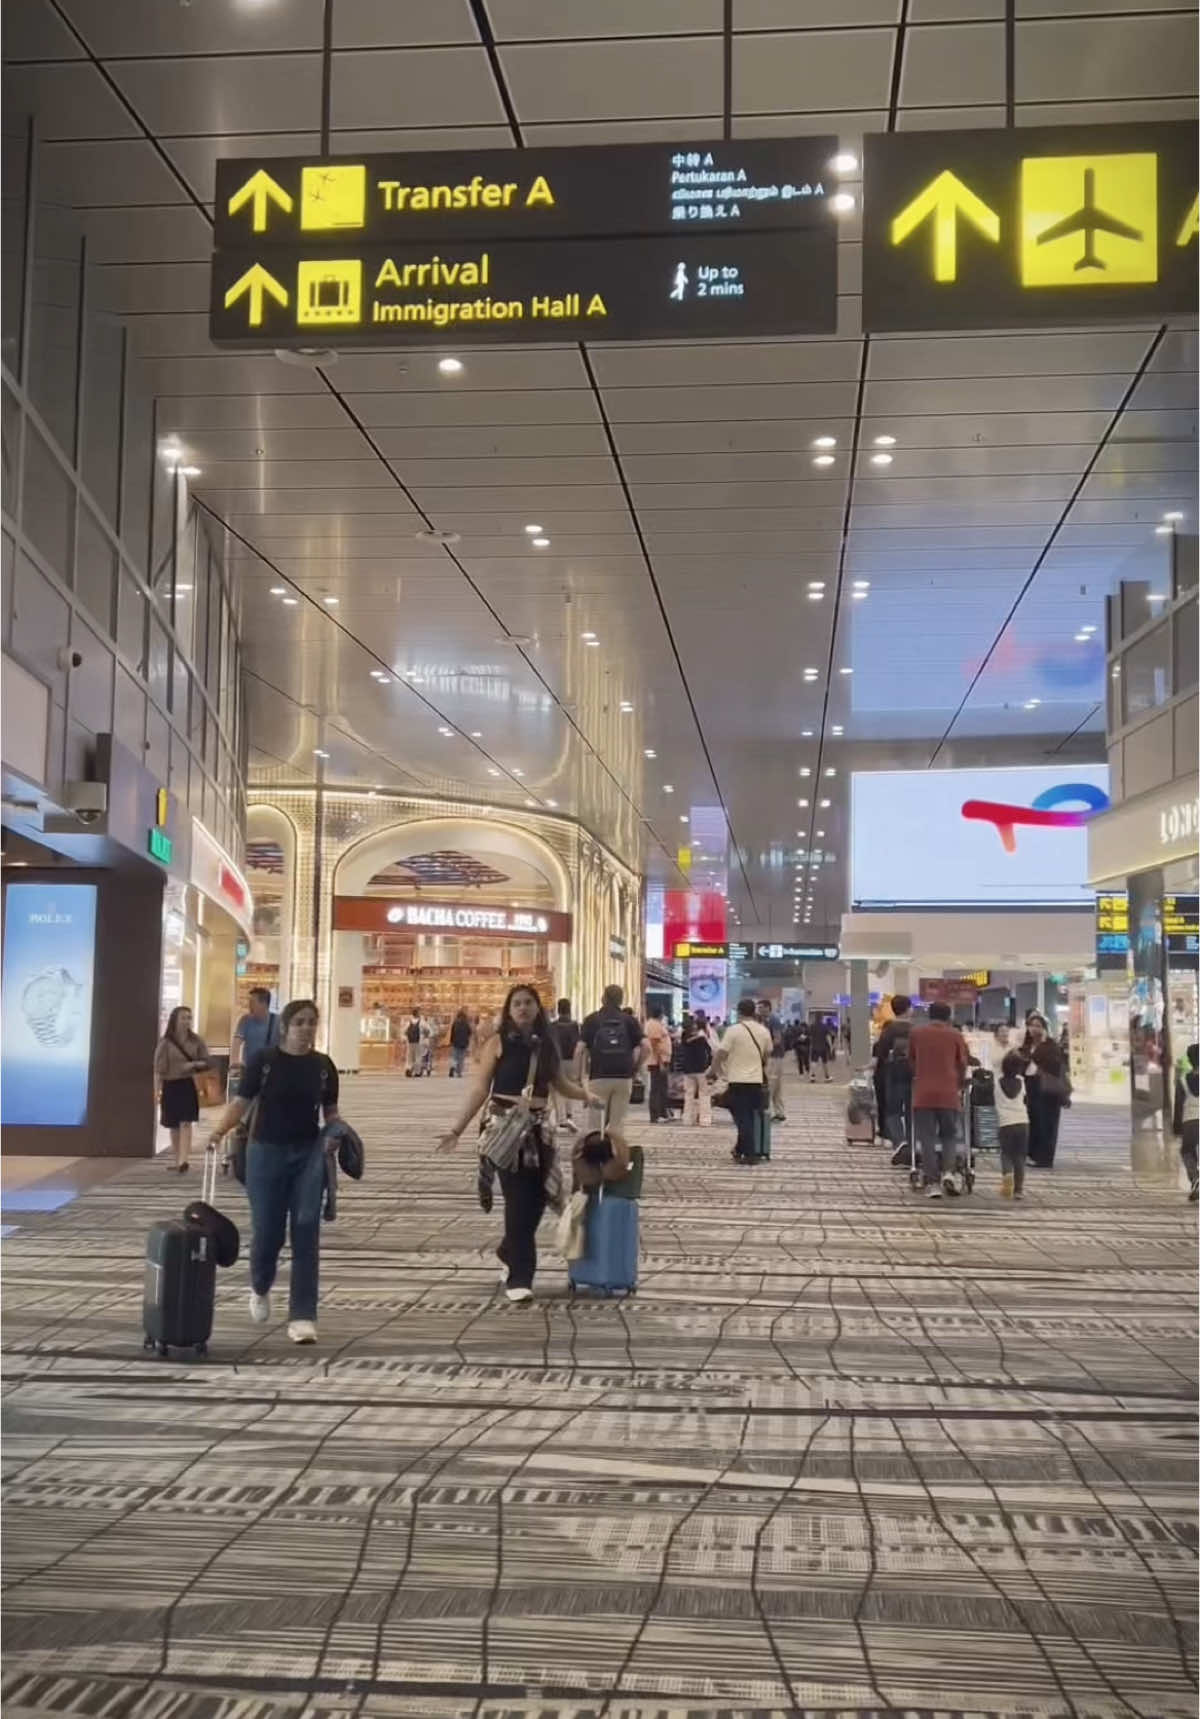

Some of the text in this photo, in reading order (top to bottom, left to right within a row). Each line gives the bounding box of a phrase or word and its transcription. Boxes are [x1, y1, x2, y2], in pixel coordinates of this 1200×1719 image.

[671, 168, 747, 184] Pertukaran A
[377, 175, 556, 211] Transfer A
[730, 204, 741, 217] A
[374, 252, 489, 288] Arrival
[697, 265, 739, 284] Up to
[697, 281, 745, 298] 2 mins
[372, 292, 608, 327] Immigration Hall A
[455, 911, 506, 930] COFFEE
